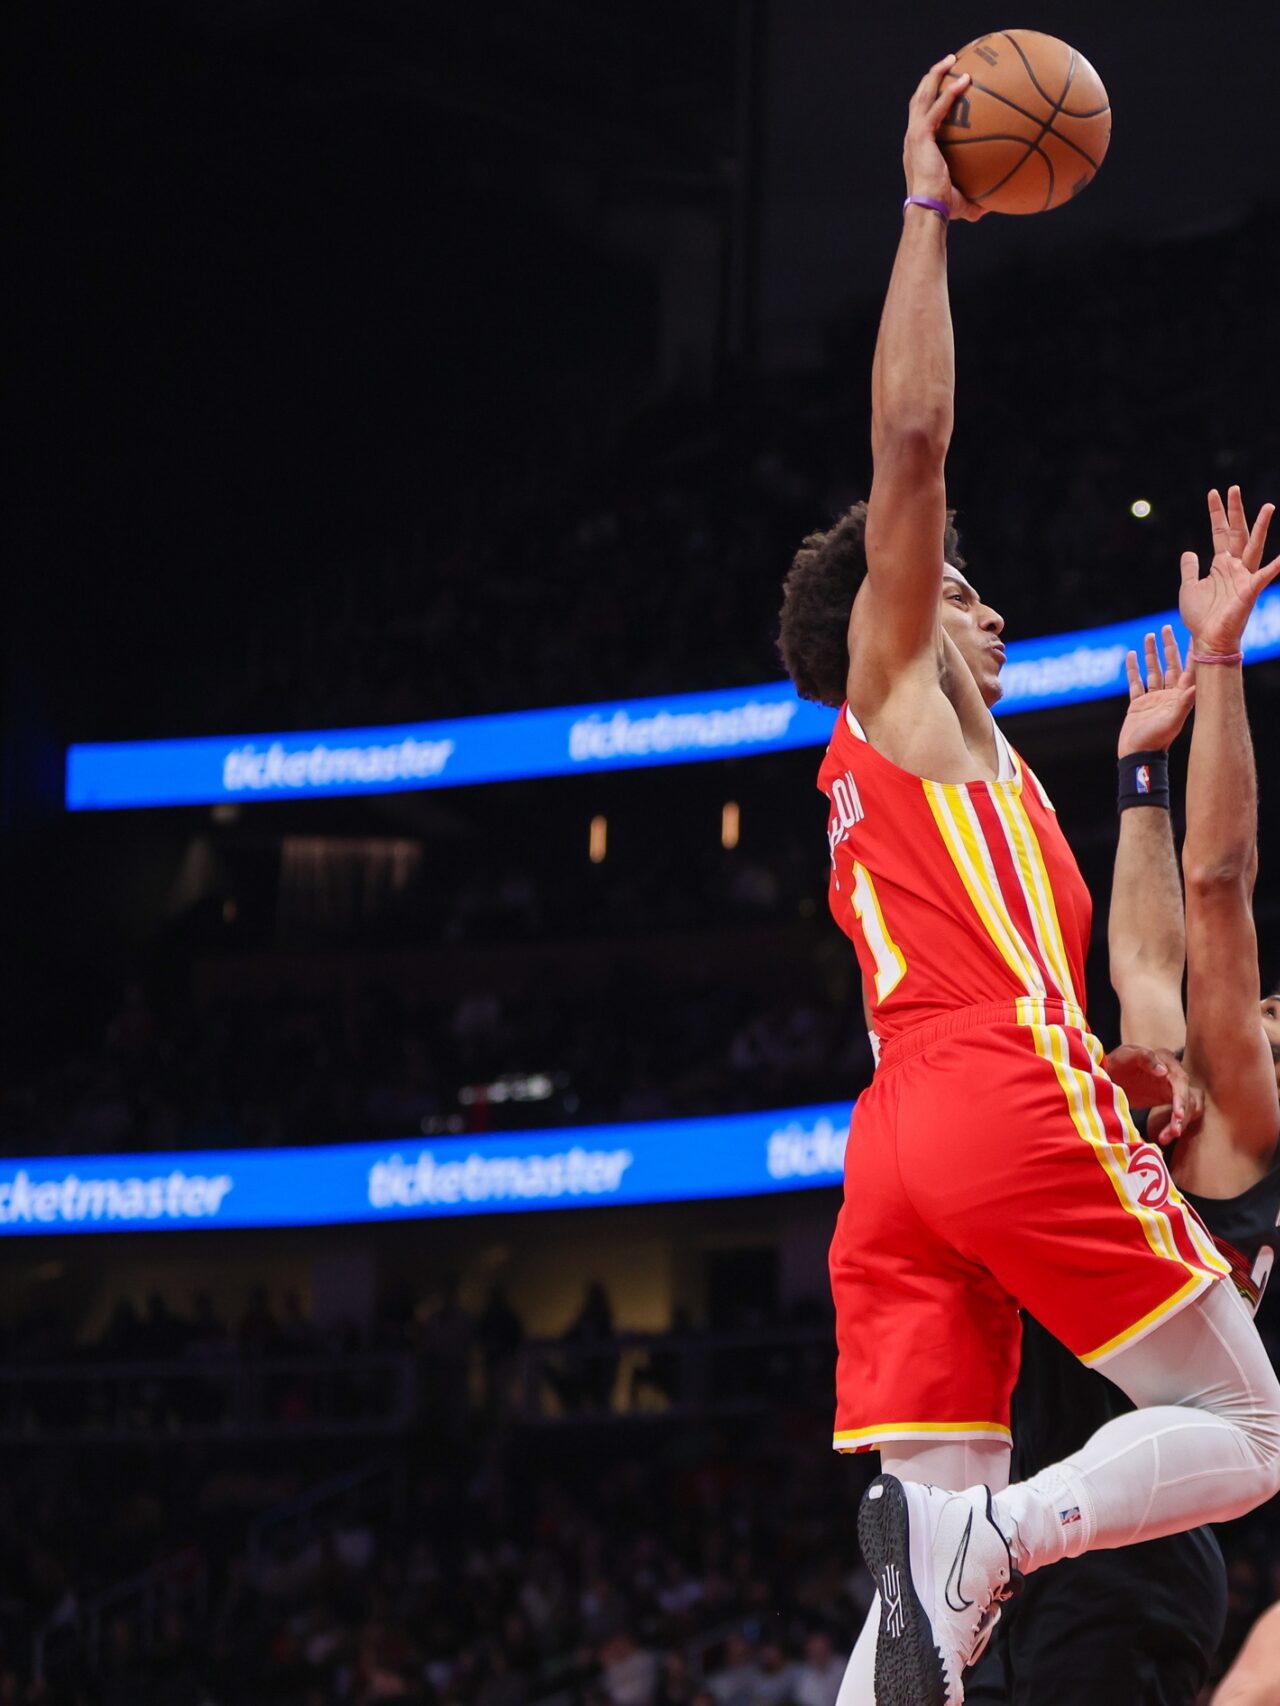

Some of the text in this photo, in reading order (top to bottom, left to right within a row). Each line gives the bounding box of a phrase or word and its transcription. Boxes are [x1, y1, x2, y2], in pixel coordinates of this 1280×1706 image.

[223, 740, 452, 789] ticketmaster
[569, 701, 795, 759] ticketmaster
[998, 645, 1128, 702] master
[850, 859, 908, 1007] 1
[0, 1169, 231, 1222] cketmaster
[369, 1148, 631, 1206] ticketmaster
